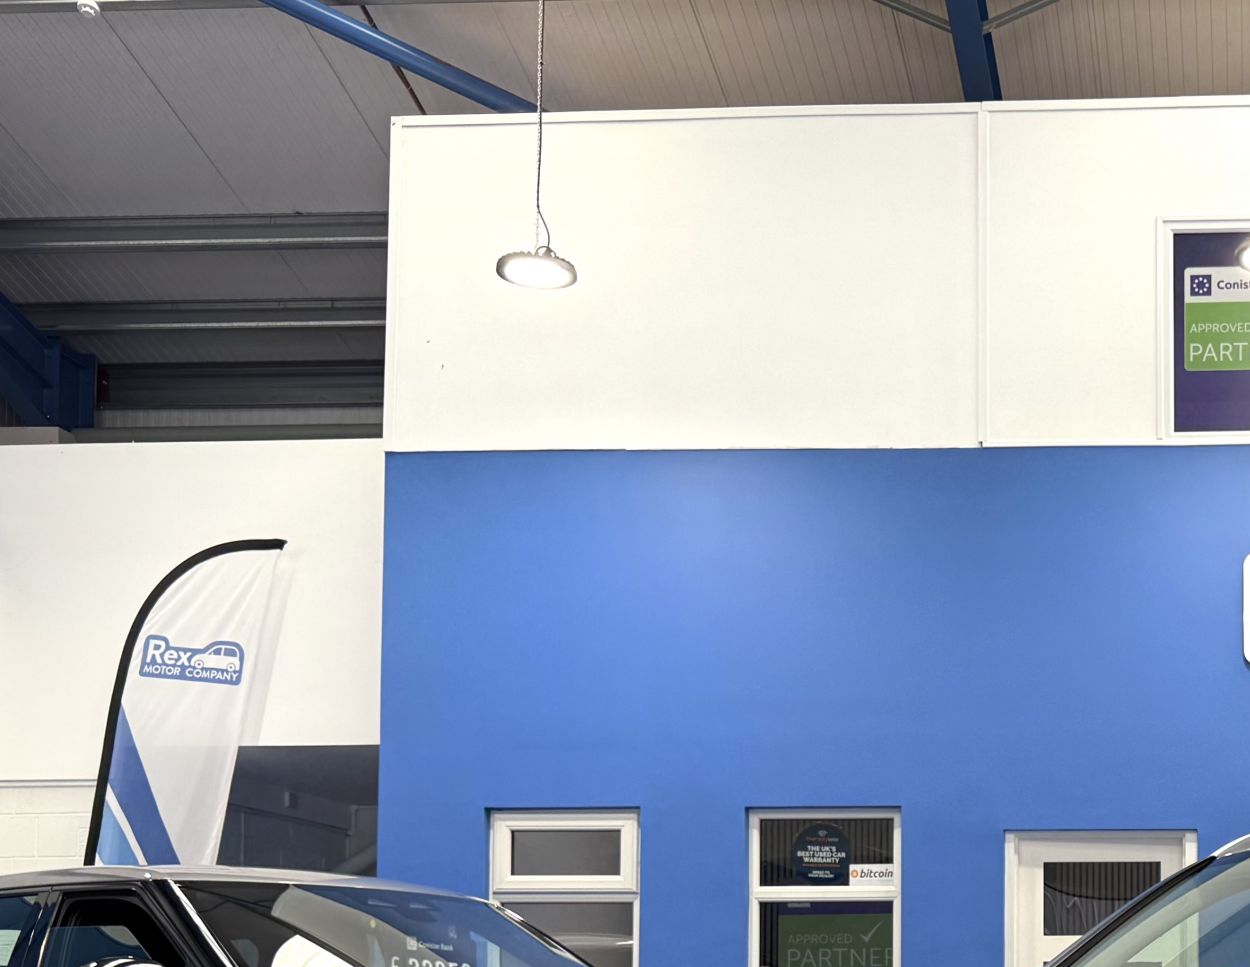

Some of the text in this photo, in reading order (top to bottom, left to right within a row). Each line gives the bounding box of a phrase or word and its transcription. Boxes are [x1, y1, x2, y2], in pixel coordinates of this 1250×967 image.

[145, 638, 192, 666] Rex
[143, 664, 239, 682] MOTOR COMPANY
[859, 868, 894, 879] bitcoin
[787, 932, 853, 945] APPROVED
